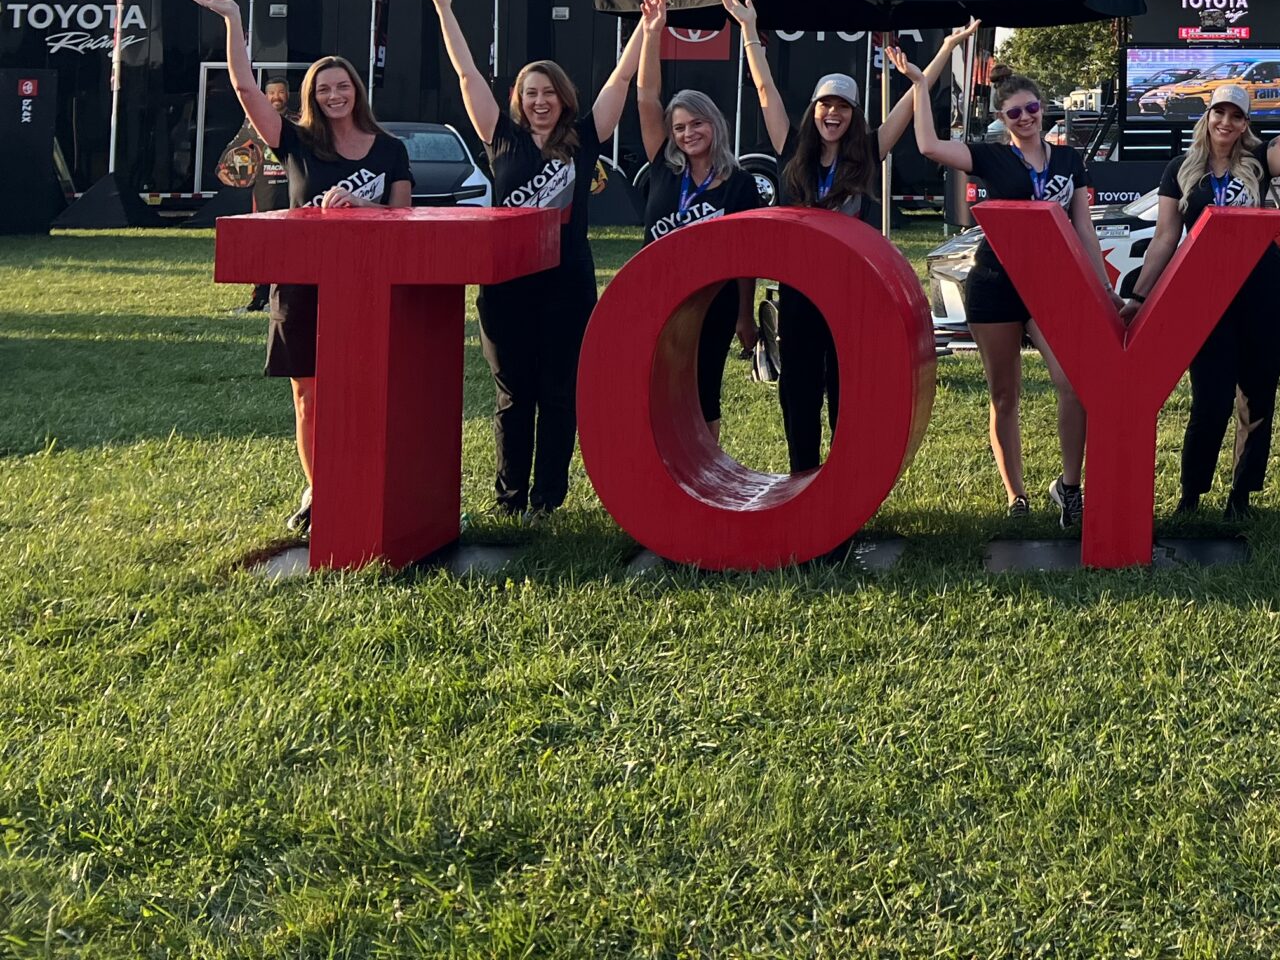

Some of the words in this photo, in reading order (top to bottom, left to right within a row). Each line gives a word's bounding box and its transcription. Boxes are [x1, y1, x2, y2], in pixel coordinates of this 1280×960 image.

[7, 3, 147, 29] TOYOTA
[21, 99, 32, 123] bZ4X
[503, 159, 565, 208] TOYOTA
[1098, 192, 1142, 202] TOYOTA
